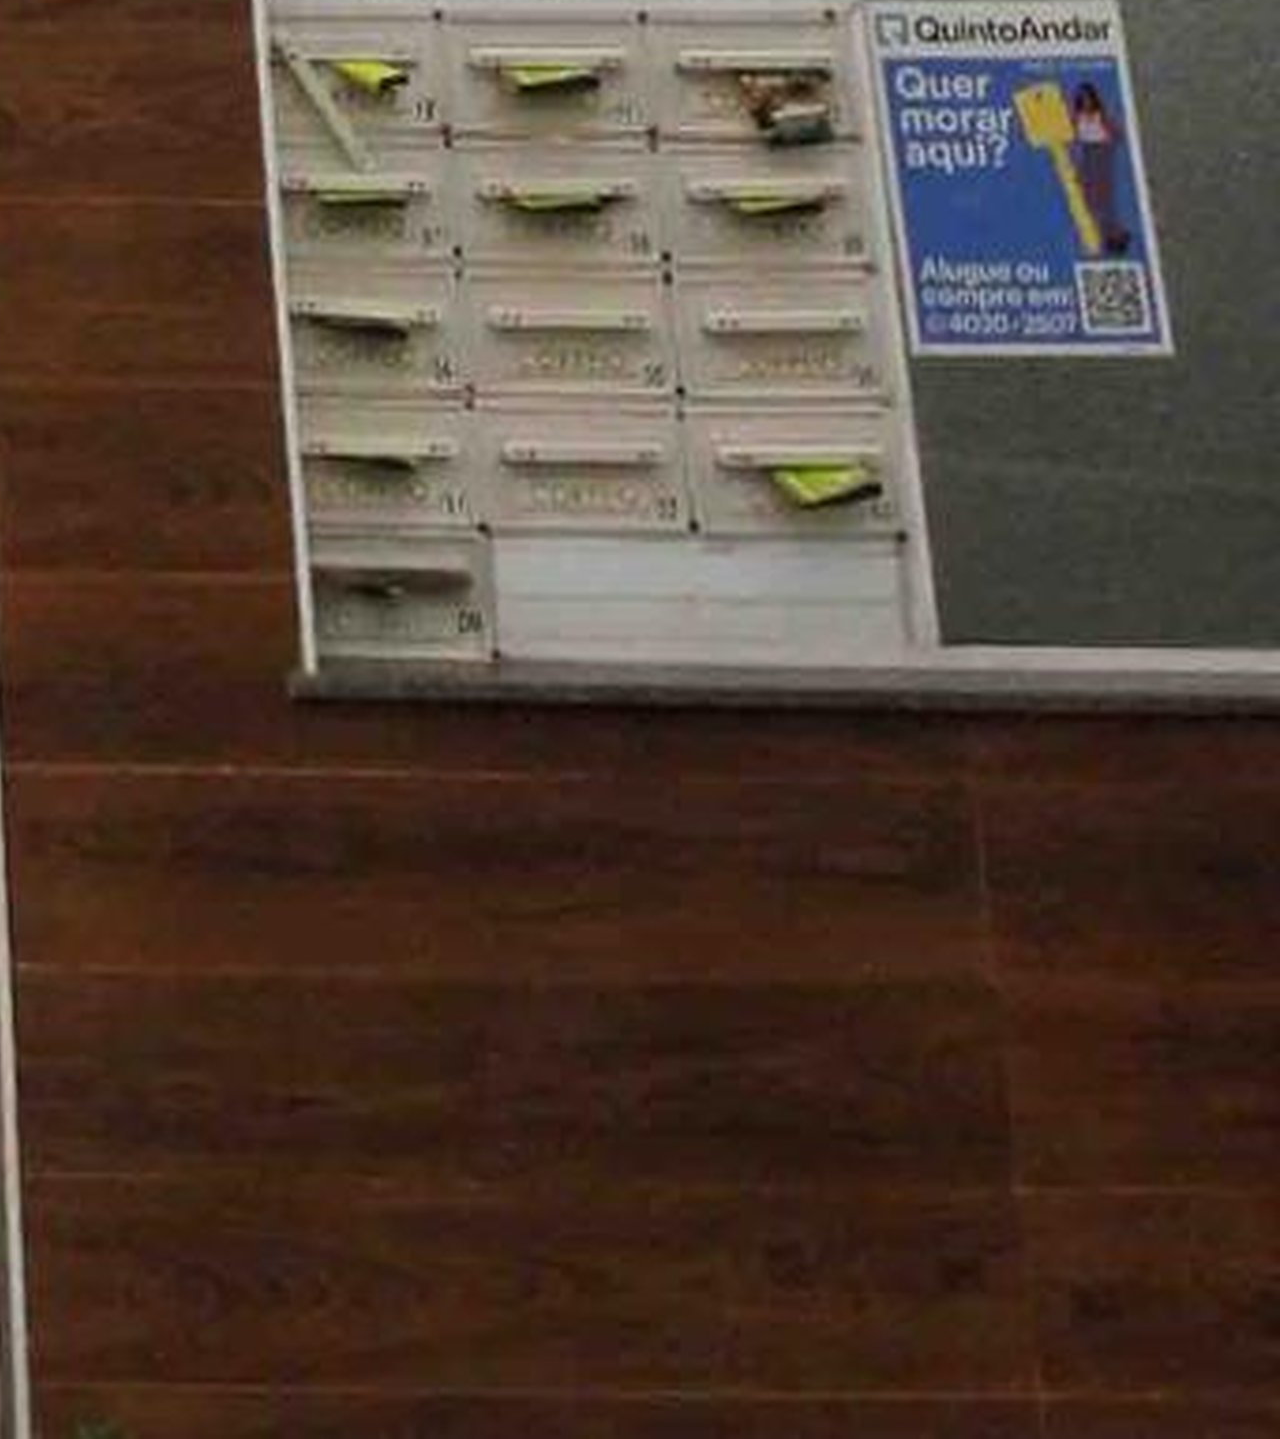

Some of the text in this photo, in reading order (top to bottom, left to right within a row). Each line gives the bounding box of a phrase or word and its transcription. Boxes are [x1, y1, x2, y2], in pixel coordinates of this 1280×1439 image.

[914, 14, 1112, 44] QuintoAndar
[895, 66, 990, 100] Quer
[901, 106, 1013, 135] morar
[905, 133, 1009, 174] aqui?
[1015, 260, 1050, 284] ou
